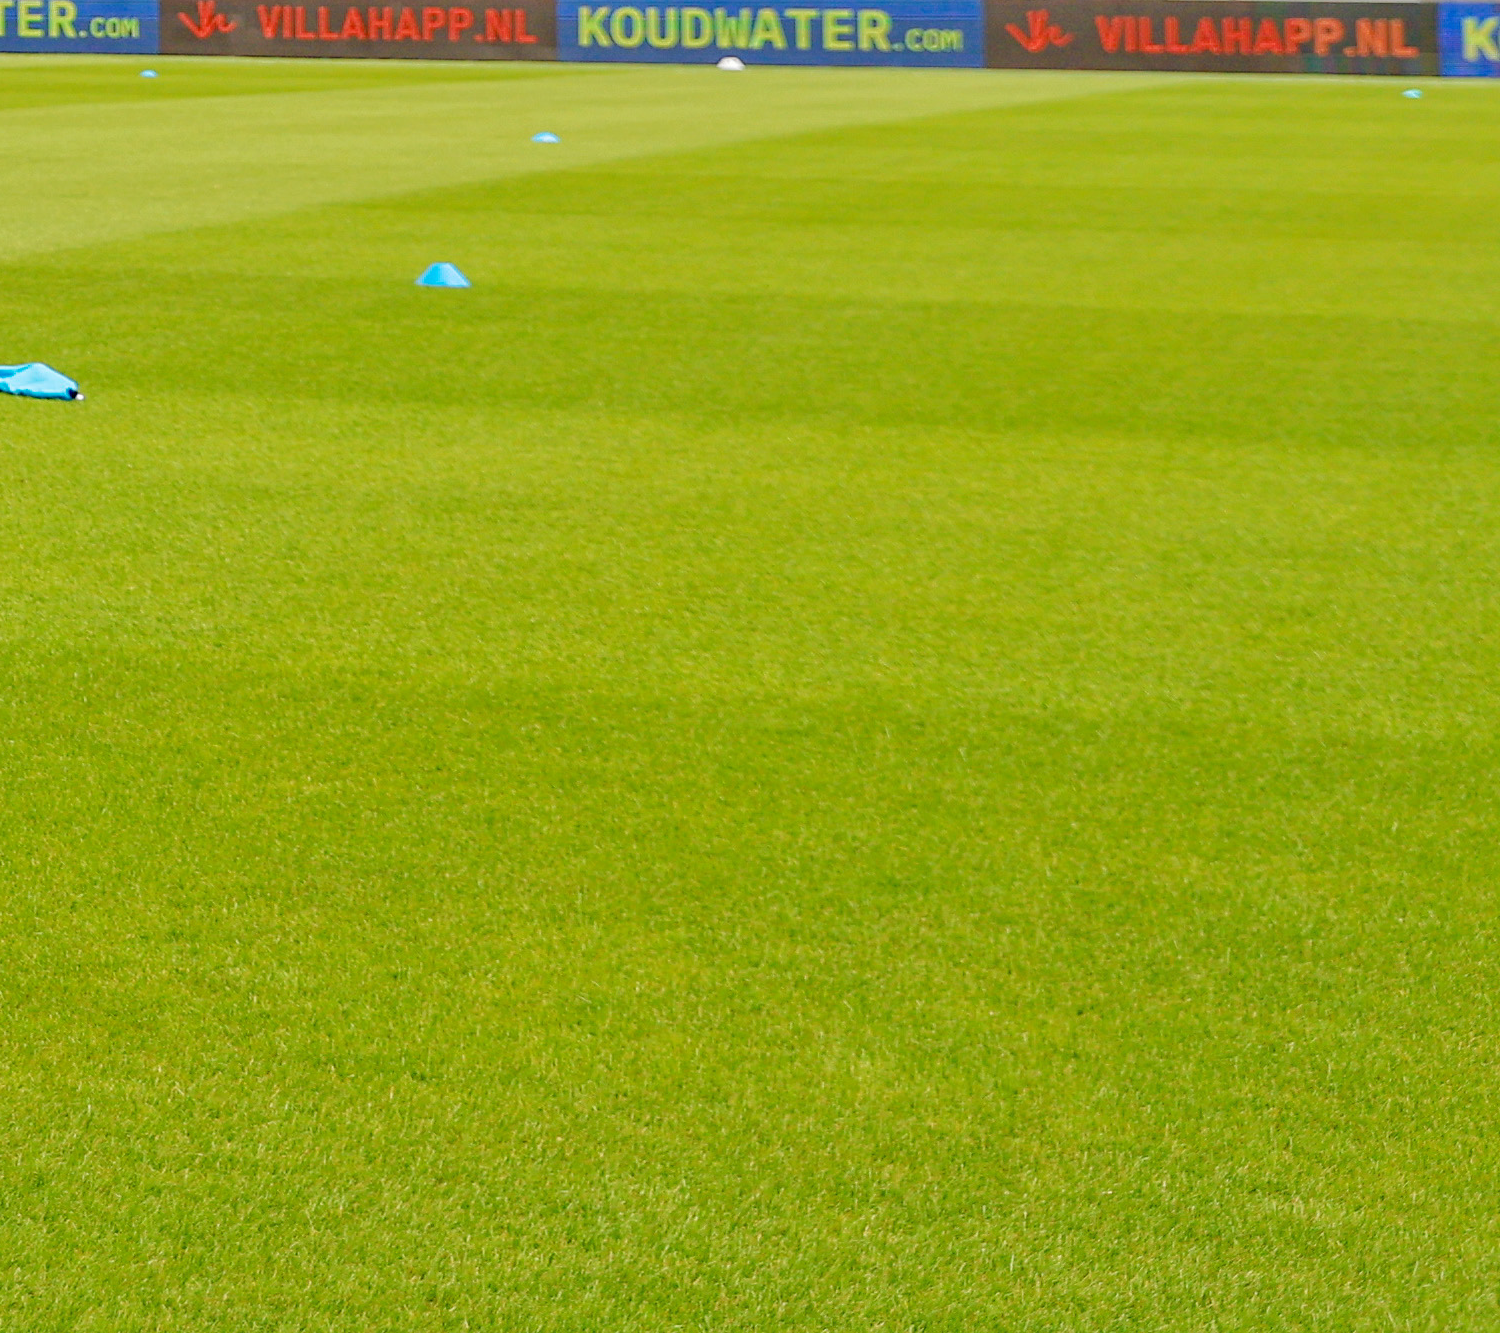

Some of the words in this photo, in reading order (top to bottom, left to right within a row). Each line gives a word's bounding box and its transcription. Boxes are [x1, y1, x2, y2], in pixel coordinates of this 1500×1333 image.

[257, 4, 538, 43] VILLAHAPP.NL
[1094, 15, 1419, 58] VILLAHAPP.NL
[1460, 16, 1500, 63] K
